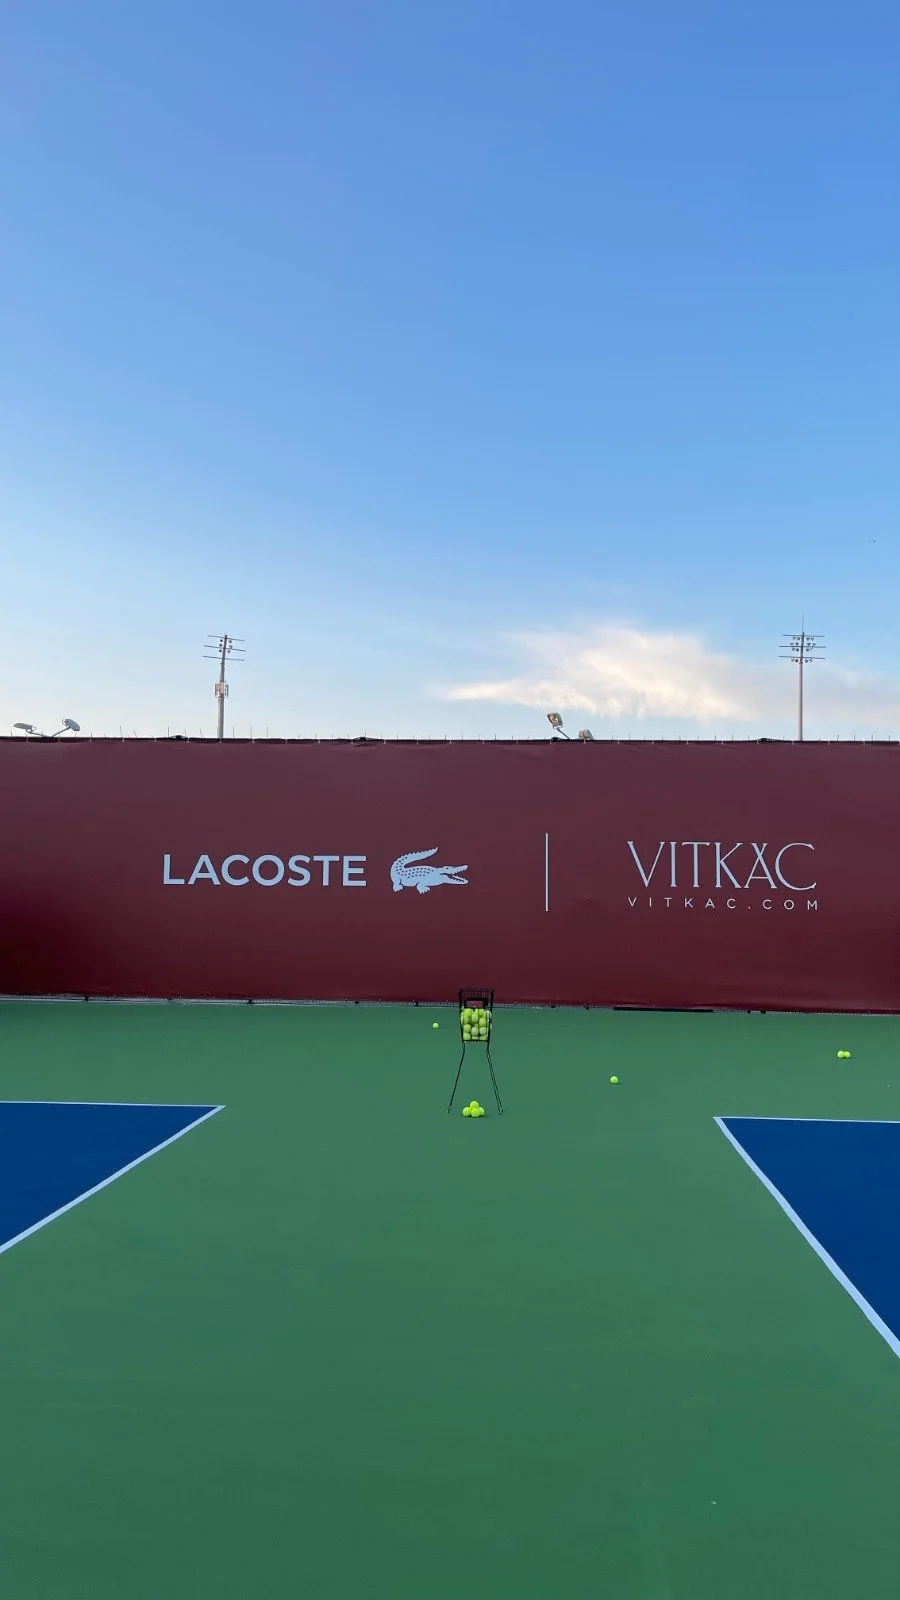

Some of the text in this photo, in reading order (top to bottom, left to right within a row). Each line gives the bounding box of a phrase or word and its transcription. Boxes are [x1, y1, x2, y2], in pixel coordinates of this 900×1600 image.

[163, 854, 367, 887] LACOSTE
[627, 841, 817, 891] VITKAC
[627, 896, 818, 911] VITKAC.COM
